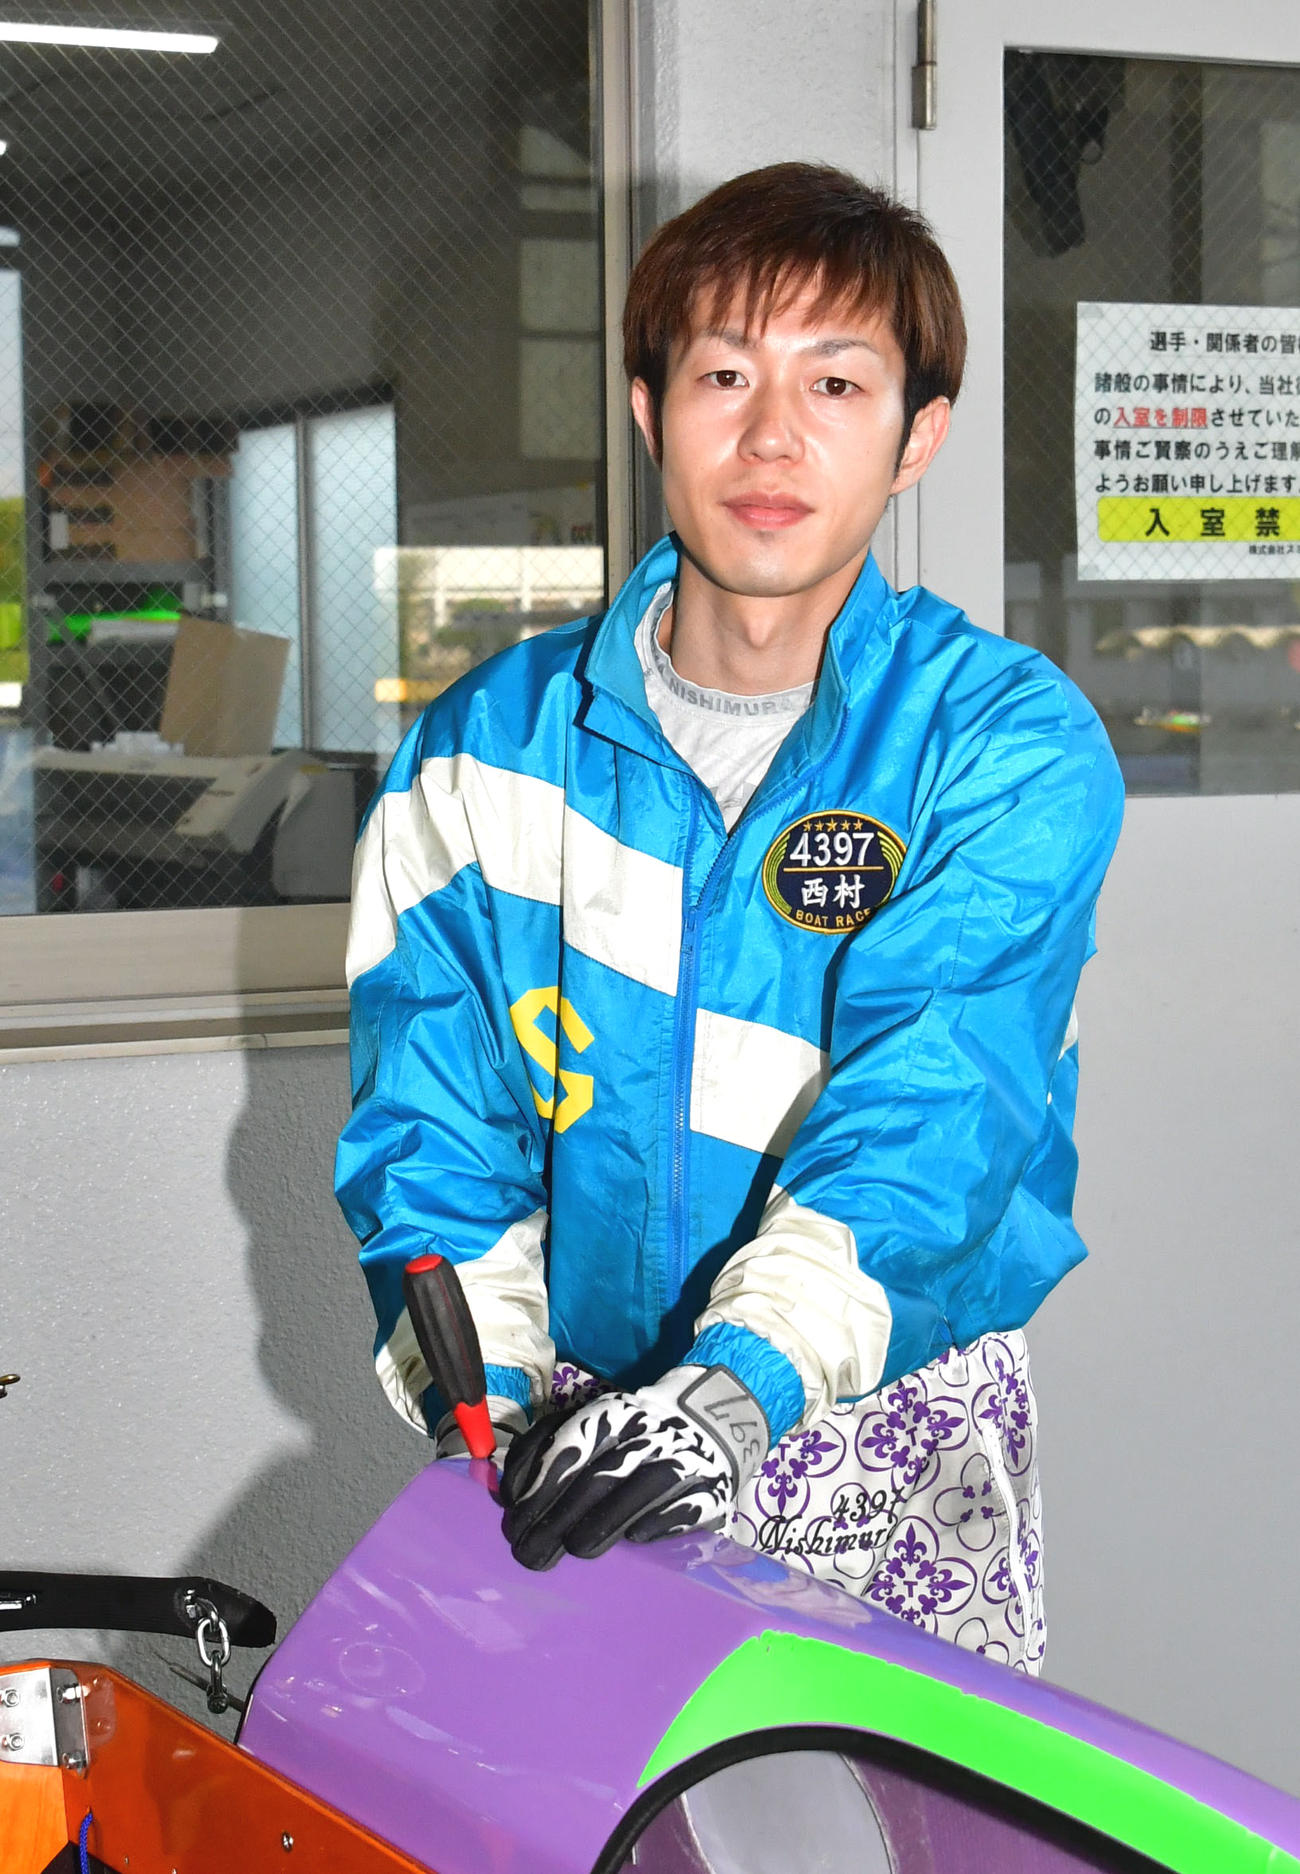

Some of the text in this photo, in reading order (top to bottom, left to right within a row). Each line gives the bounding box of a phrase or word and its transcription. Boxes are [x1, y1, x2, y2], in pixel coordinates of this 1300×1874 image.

[1150, 331, 1300, 354] 選手・関係者の皆
[1094, 406, 1300, 428] の入室を制限させていた
[1095, 474, 1300, 494] ようお願い申し上げます
[789, 832, 875, 867] 4397
[801, 874, 865, 909] 西村
[795, 909, 829, 927] BOAT
